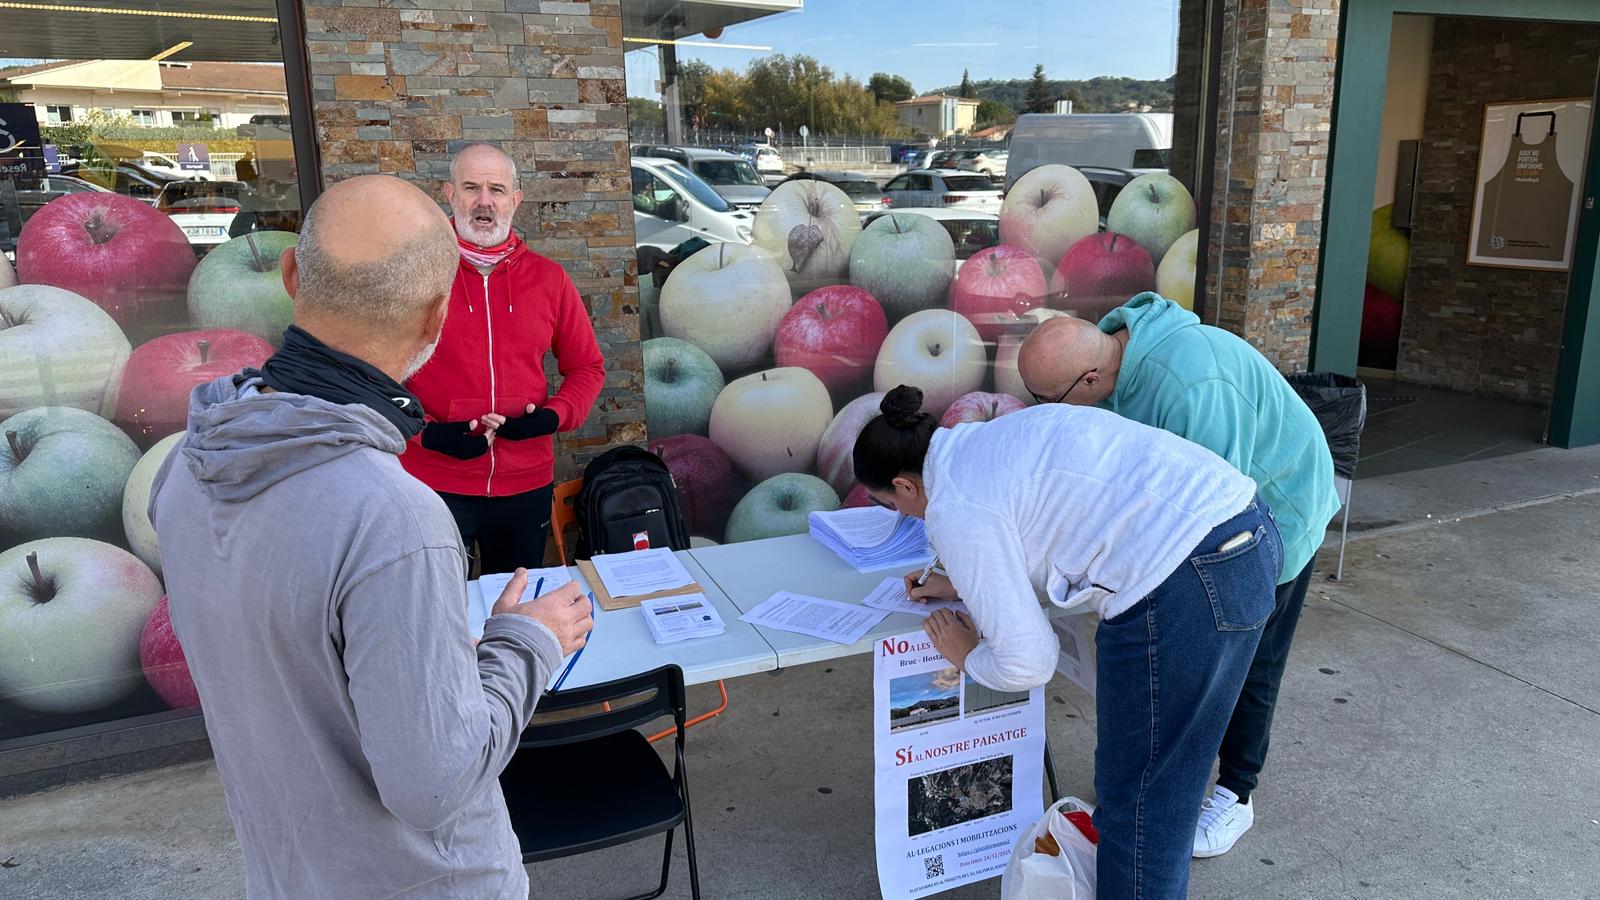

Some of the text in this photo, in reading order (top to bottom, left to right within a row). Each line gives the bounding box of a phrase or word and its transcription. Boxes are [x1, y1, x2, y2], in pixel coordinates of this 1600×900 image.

[881, 638, 909, 657] No
[916, 642, 930, 651] LES
[900, 658, 916, 667] Bruc
[896, 746, 912, 766] Sí
[915, 754, 924, 762] AL
[925, 740, 970, 760] NOSTRE
[972, 728, 1028, 748] PAISATGE
[960, 824, 1018, 844] MOBILITZACIONS
